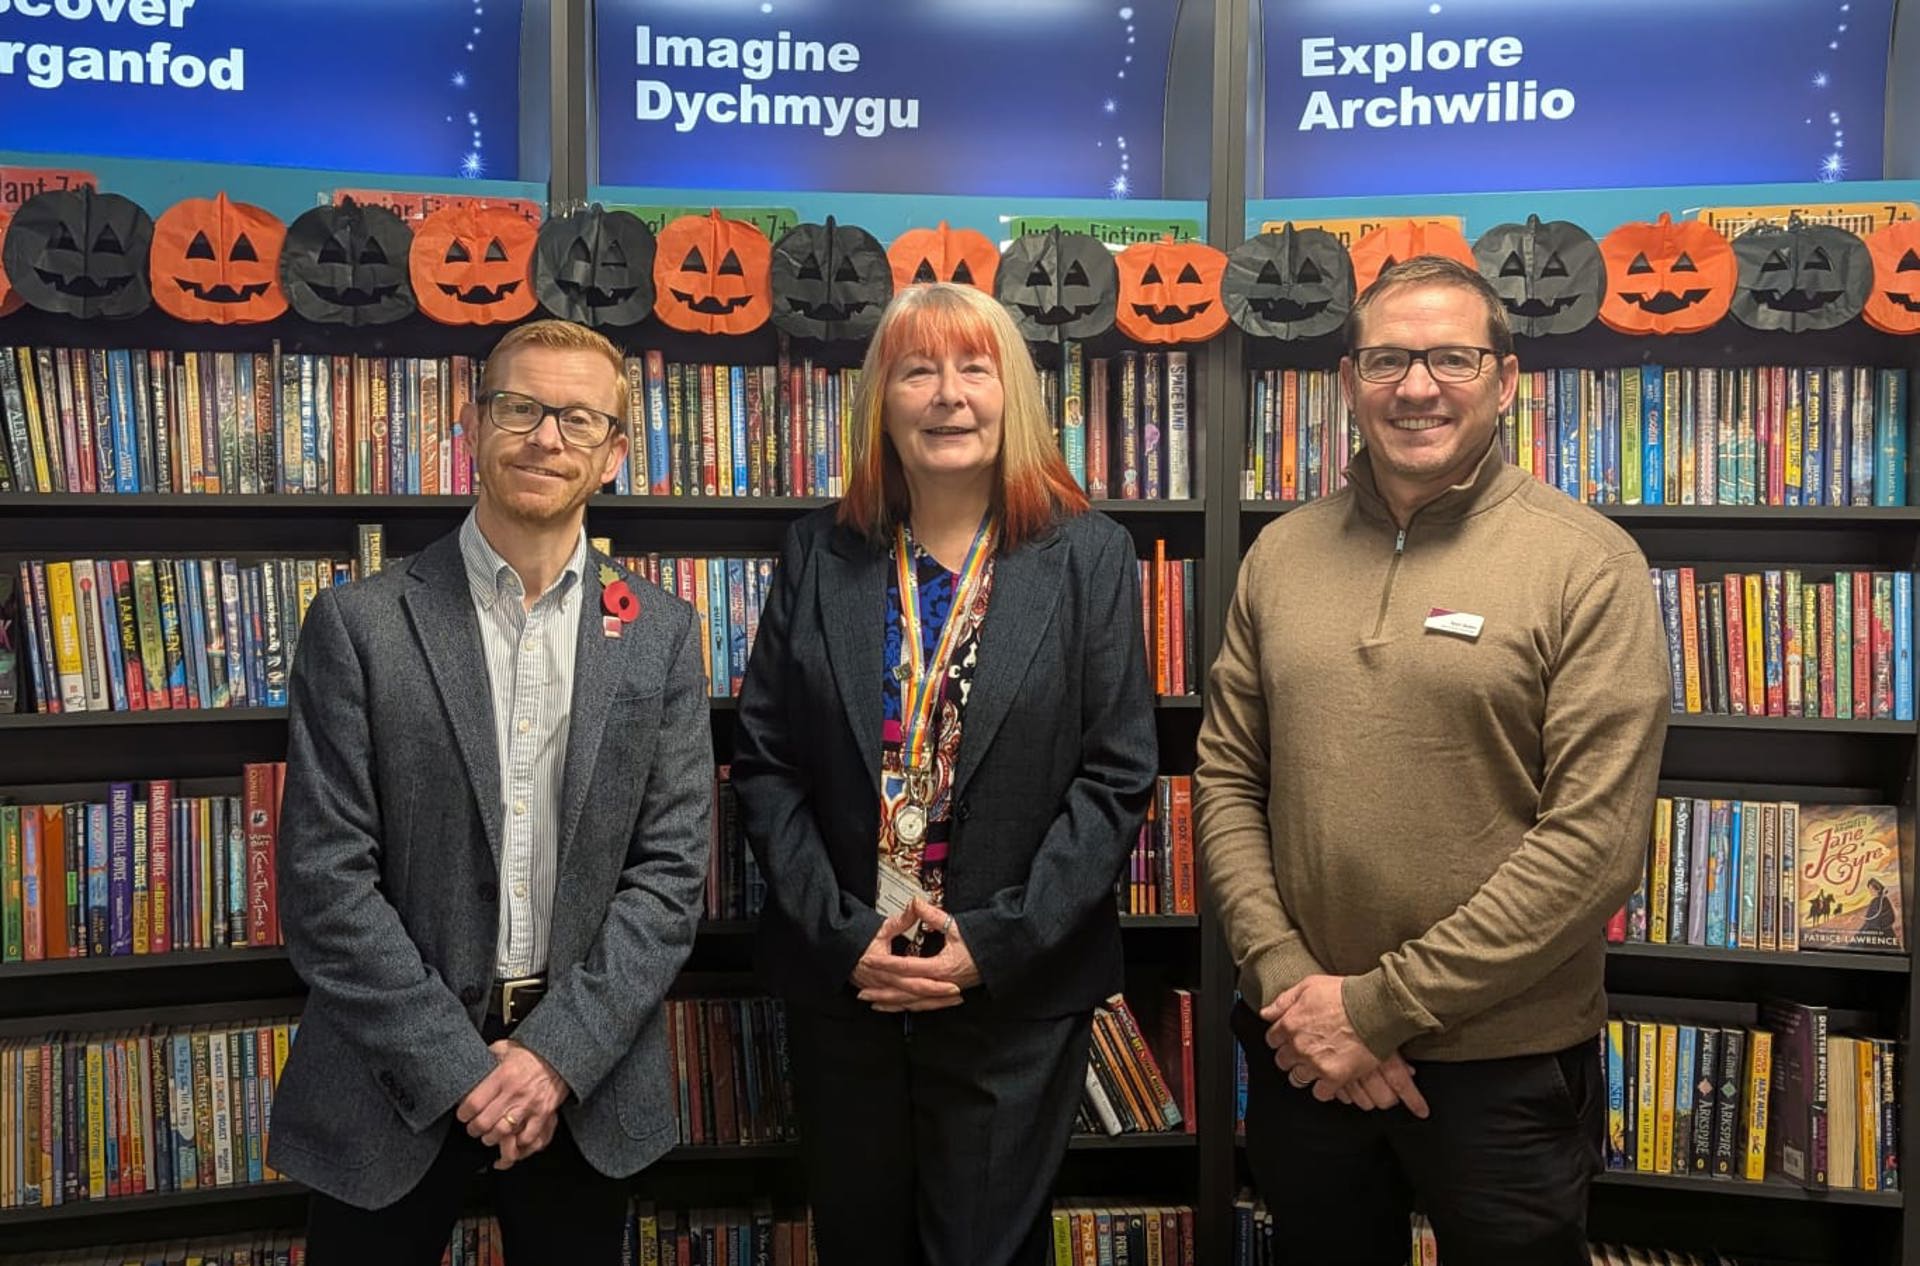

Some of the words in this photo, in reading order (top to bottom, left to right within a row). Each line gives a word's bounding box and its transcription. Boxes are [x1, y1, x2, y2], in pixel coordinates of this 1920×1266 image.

[0, 0, 195, 27] cover
[0, 41, 244, 91] rganfod
[636, 25, 860, 80] Imagine
[1302, 31, 1523, 83] Explore
[636, 80, 919, 137] Dychmygu
[1299, 80, 1575, 130] Archwilio
[1809, 374, 1820, 393] THE
[1808, 396, 1820, 422] GOOD
[663, 566, 673, 594] CHEC
[134, 804, 146, 828] FRANK
[152, 785, 165, 811] FRANK
[153, 813, 166, 876] COTTRELL-BOYCE
[1805, 827, 1865, 879] Jane
[1822, 843, 1885, 896] Eyre
[1803, 933, 1842, 944] PATRICE
[1845, 935, 1898, 946] LAWRENCE
[1696, 1099, 1713, 1155] ARKSPIRE
[1717, 1102, 1734, 1157] ARKSPIRE
